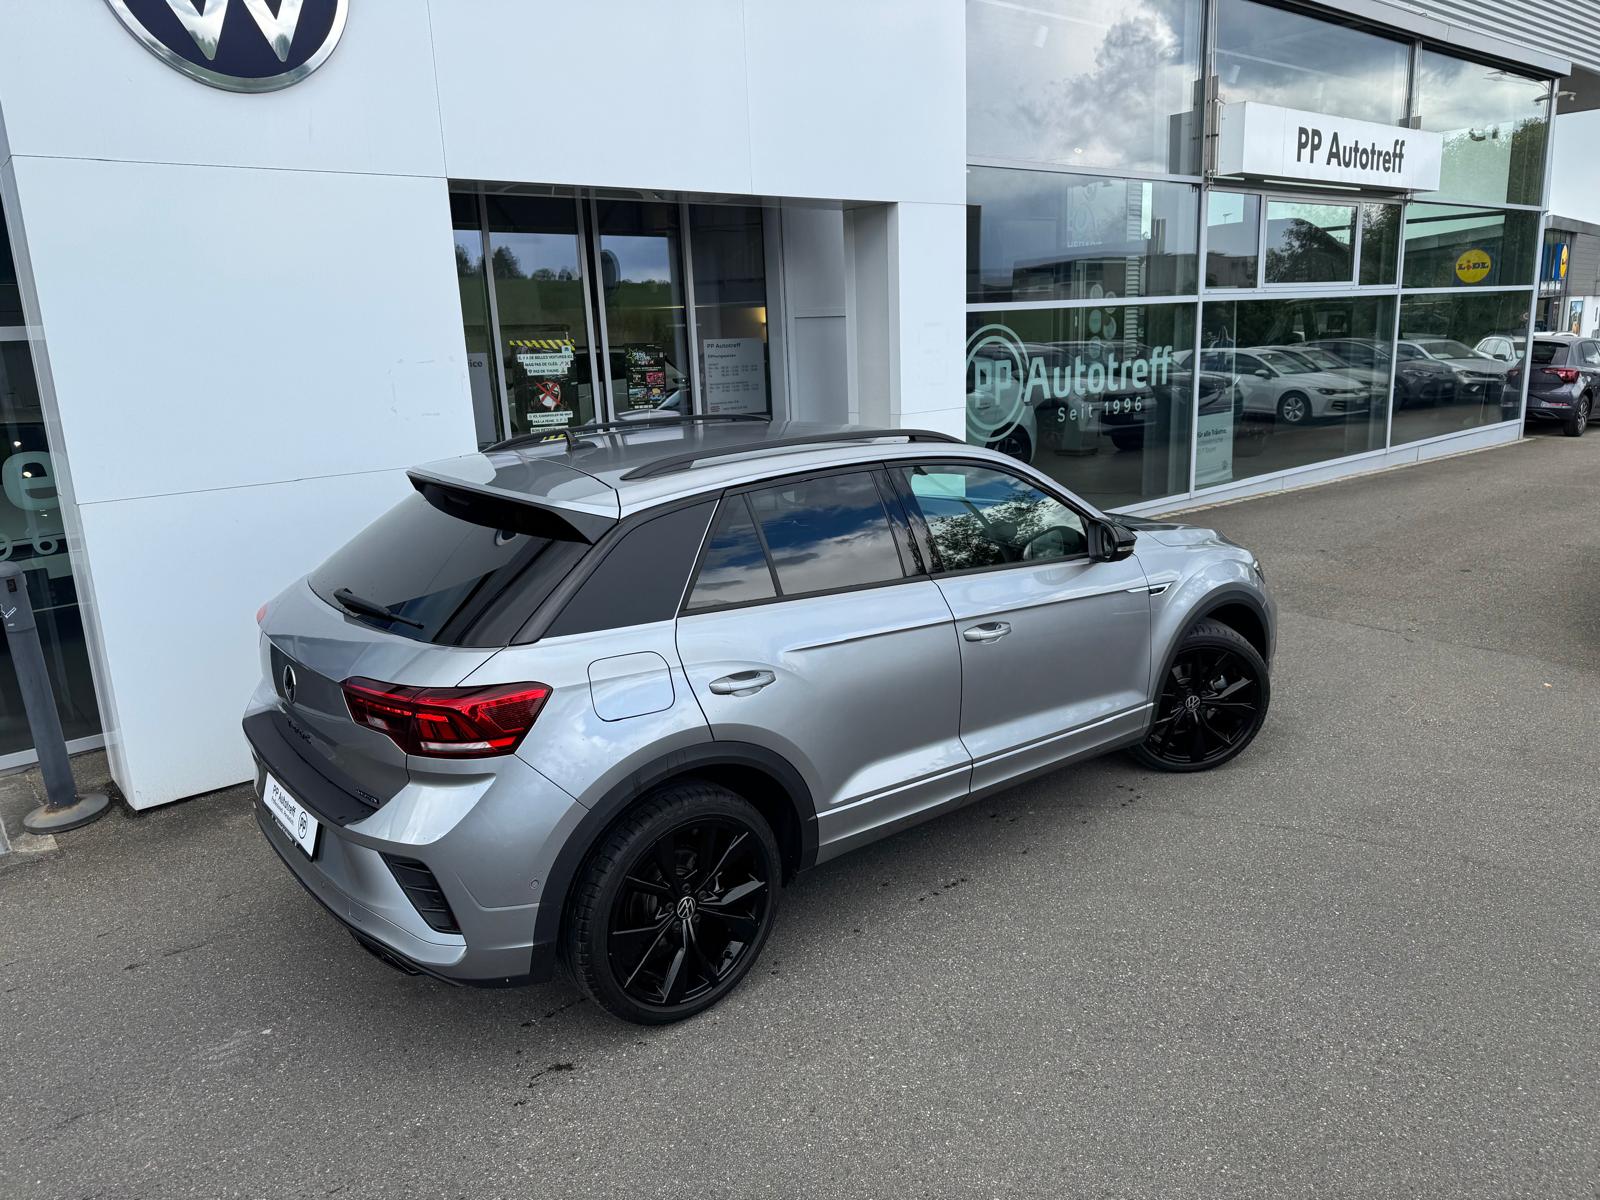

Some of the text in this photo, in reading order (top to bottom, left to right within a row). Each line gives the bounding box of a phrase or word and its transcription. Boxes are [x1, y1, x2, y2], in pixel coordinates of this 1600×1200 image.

[1297, 126, 1406, 173] PP Autotreff
[1024, 345, 1174, 403] Autotreff
[1057, 396, 1142, 423] Seit 1996
